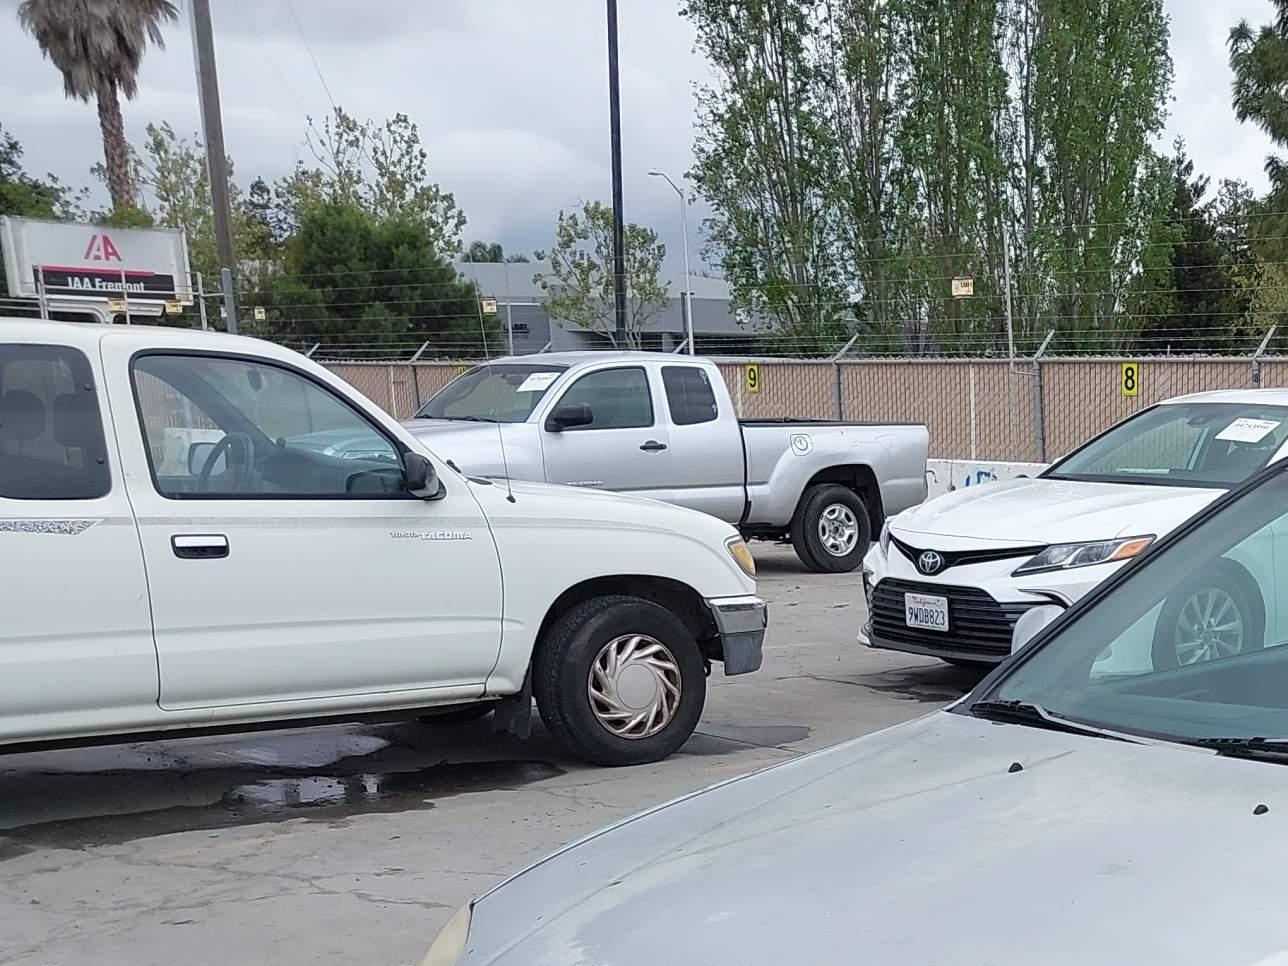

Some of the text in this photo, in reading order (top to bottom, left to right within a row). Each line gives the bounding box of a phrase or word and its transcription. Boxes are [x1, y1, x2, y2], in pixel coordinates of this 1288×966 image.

[67, 276, 145, 292] IAA Fremont
[748, 367, 757, 388] 9
[1124, 366, 1136, 391] 8
[420, 531, 473, 540] TACOMA
[908, 606, 945, 626] 9WDB823
